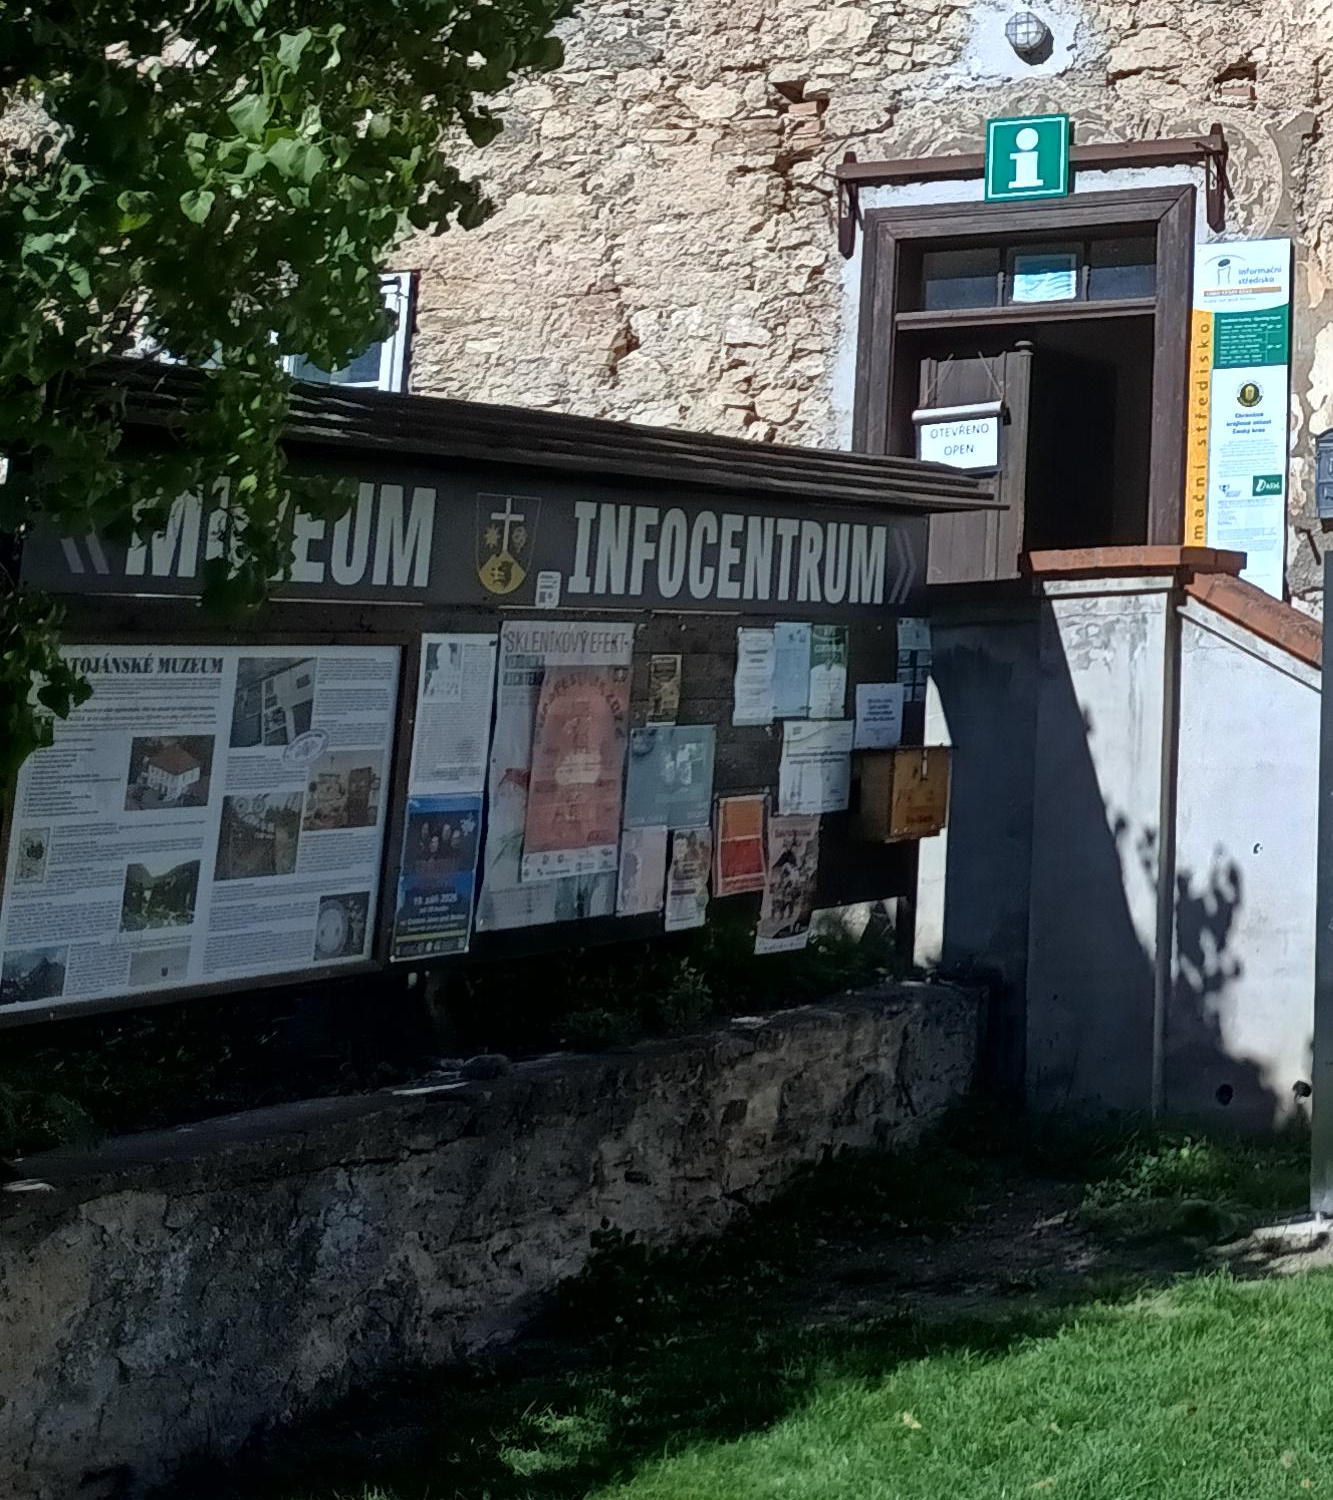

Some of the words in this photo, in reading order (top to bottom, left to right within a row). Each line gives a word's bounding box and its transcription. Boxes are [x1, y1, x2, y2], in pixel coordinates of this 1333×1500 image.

[1238, 265, 1282, 275] Informační
[1238, 276, 1275, 285] středisko
[1194, 323, 1211, 447] středisko
[930, 422, 990, 439] OTEVŘENO
[943, 444, 975, 456] OPEN
[125, 475, 437, 588] MEUM
[567, 501, 887, 605] INFOCENTRUM
[157, 657, 224, 674] MUZEUM
